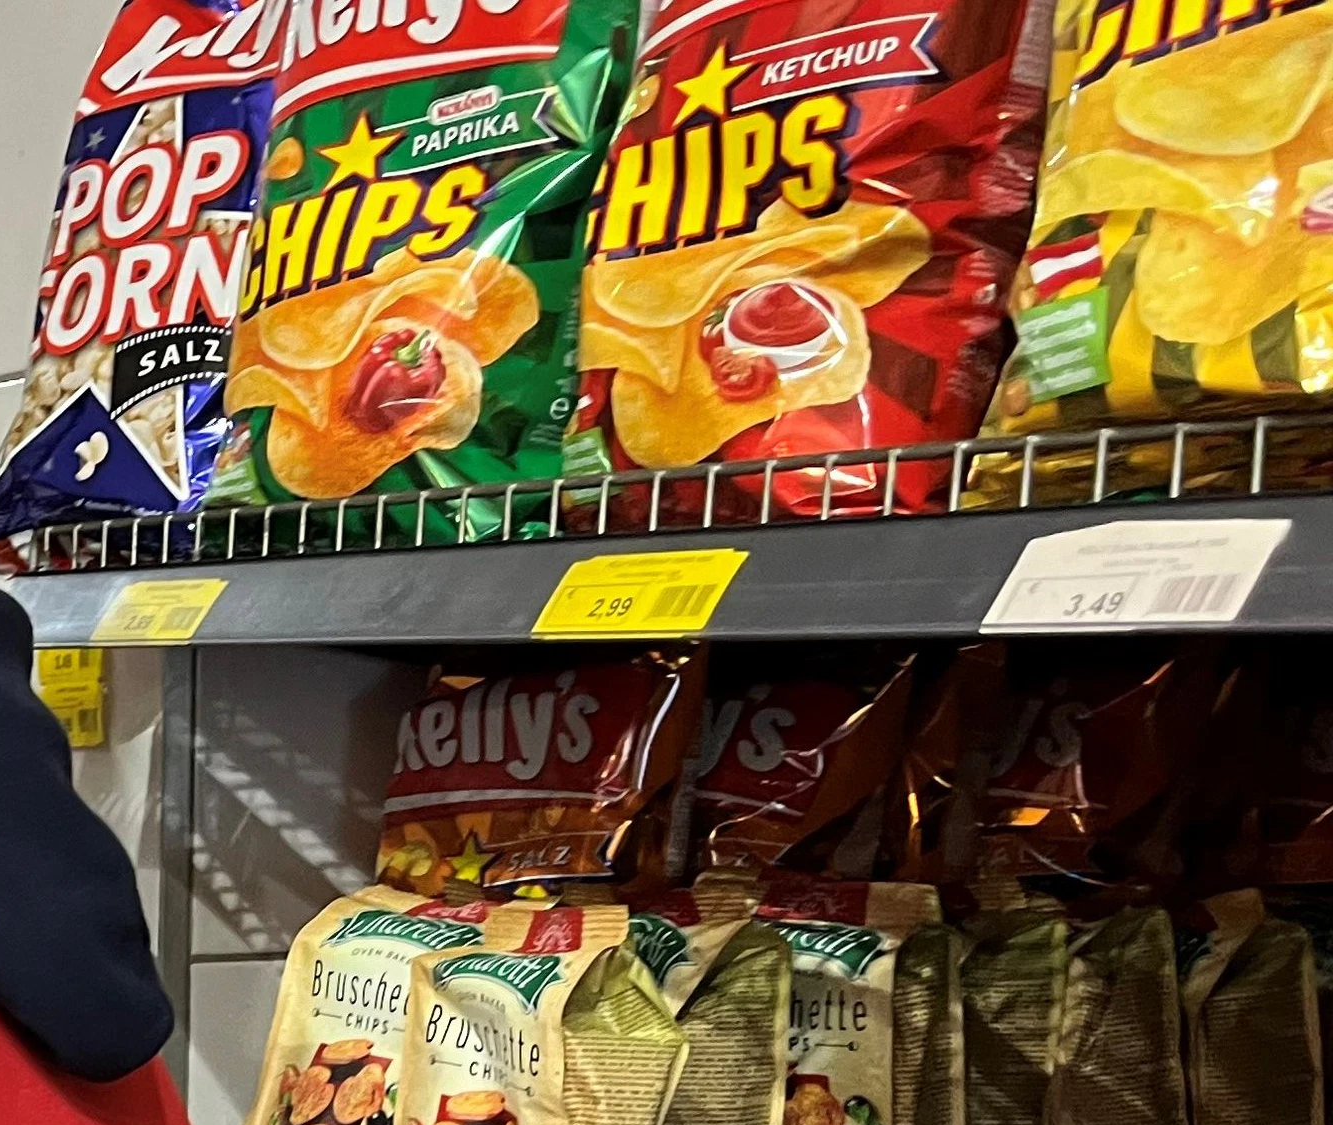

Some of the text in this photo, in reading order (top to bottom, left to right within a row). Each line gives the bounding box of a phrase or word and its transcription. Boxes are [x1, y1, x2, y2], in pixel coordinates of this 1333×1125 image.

[760, 37, 900, 87] KETCHUP
[411, 111, 520, 157] PAPRIKA
[54, 133, 242, 259] POP
[584, 96, 847, 252] HIPS
[137, 333, 224, 377] SALZ
[587, 597, 633, 620] 2,99
[1063, 591, 1125, 617] 3,49
[386, 950, 411, 964] BAKE
[345, 1012, 390, 1035] CHIPS
